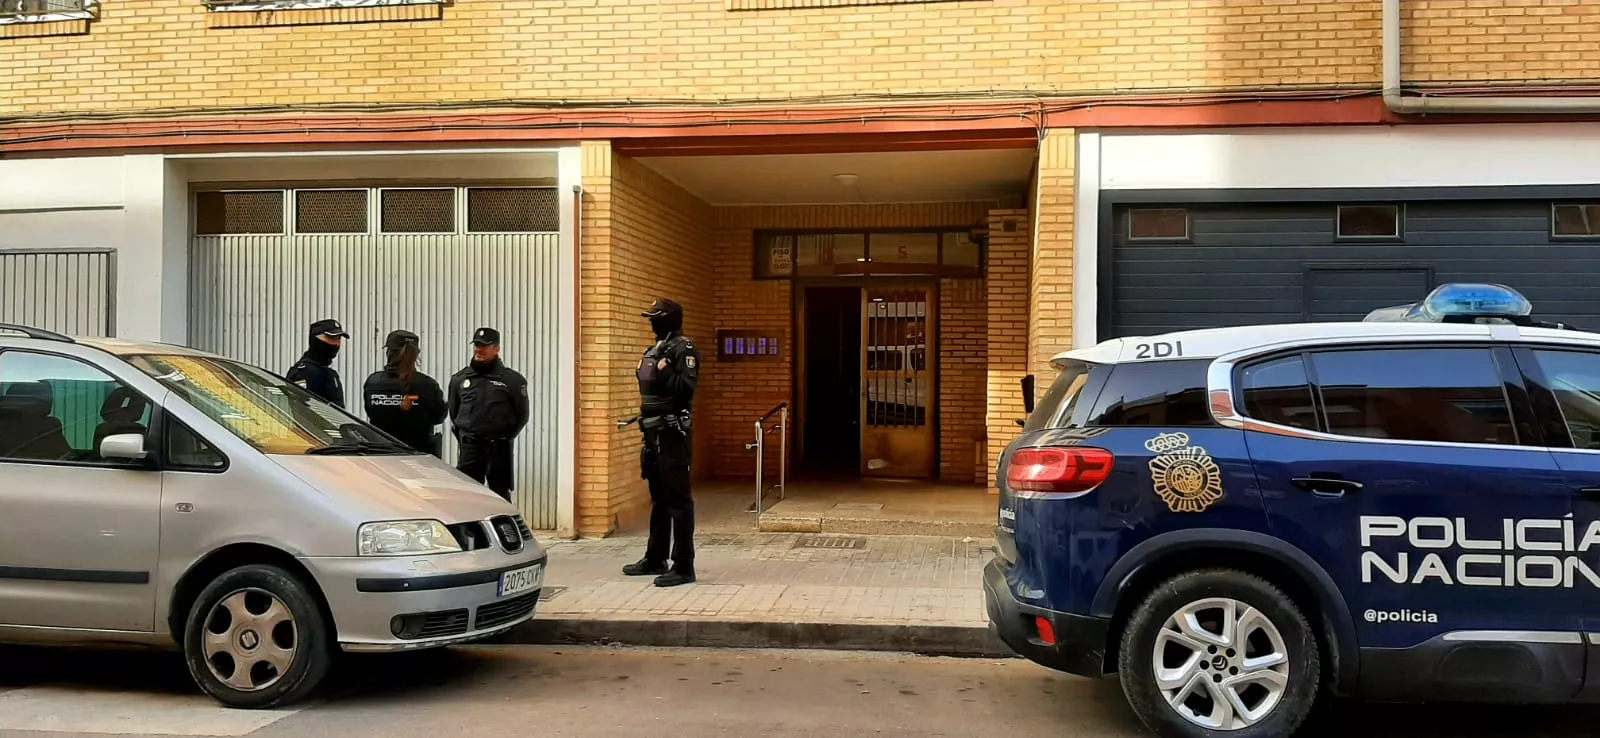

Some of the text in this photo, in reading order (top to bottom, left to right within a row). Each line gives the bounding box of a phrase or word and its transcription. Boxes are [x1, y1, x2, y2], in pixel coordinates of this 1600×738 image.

[898, 246, 907, 259] 5
[1136, 341, 1183, 359] 2DI
[504, 571, 525, 592] 2075
[1363, 608, 1438, 624] @policia
